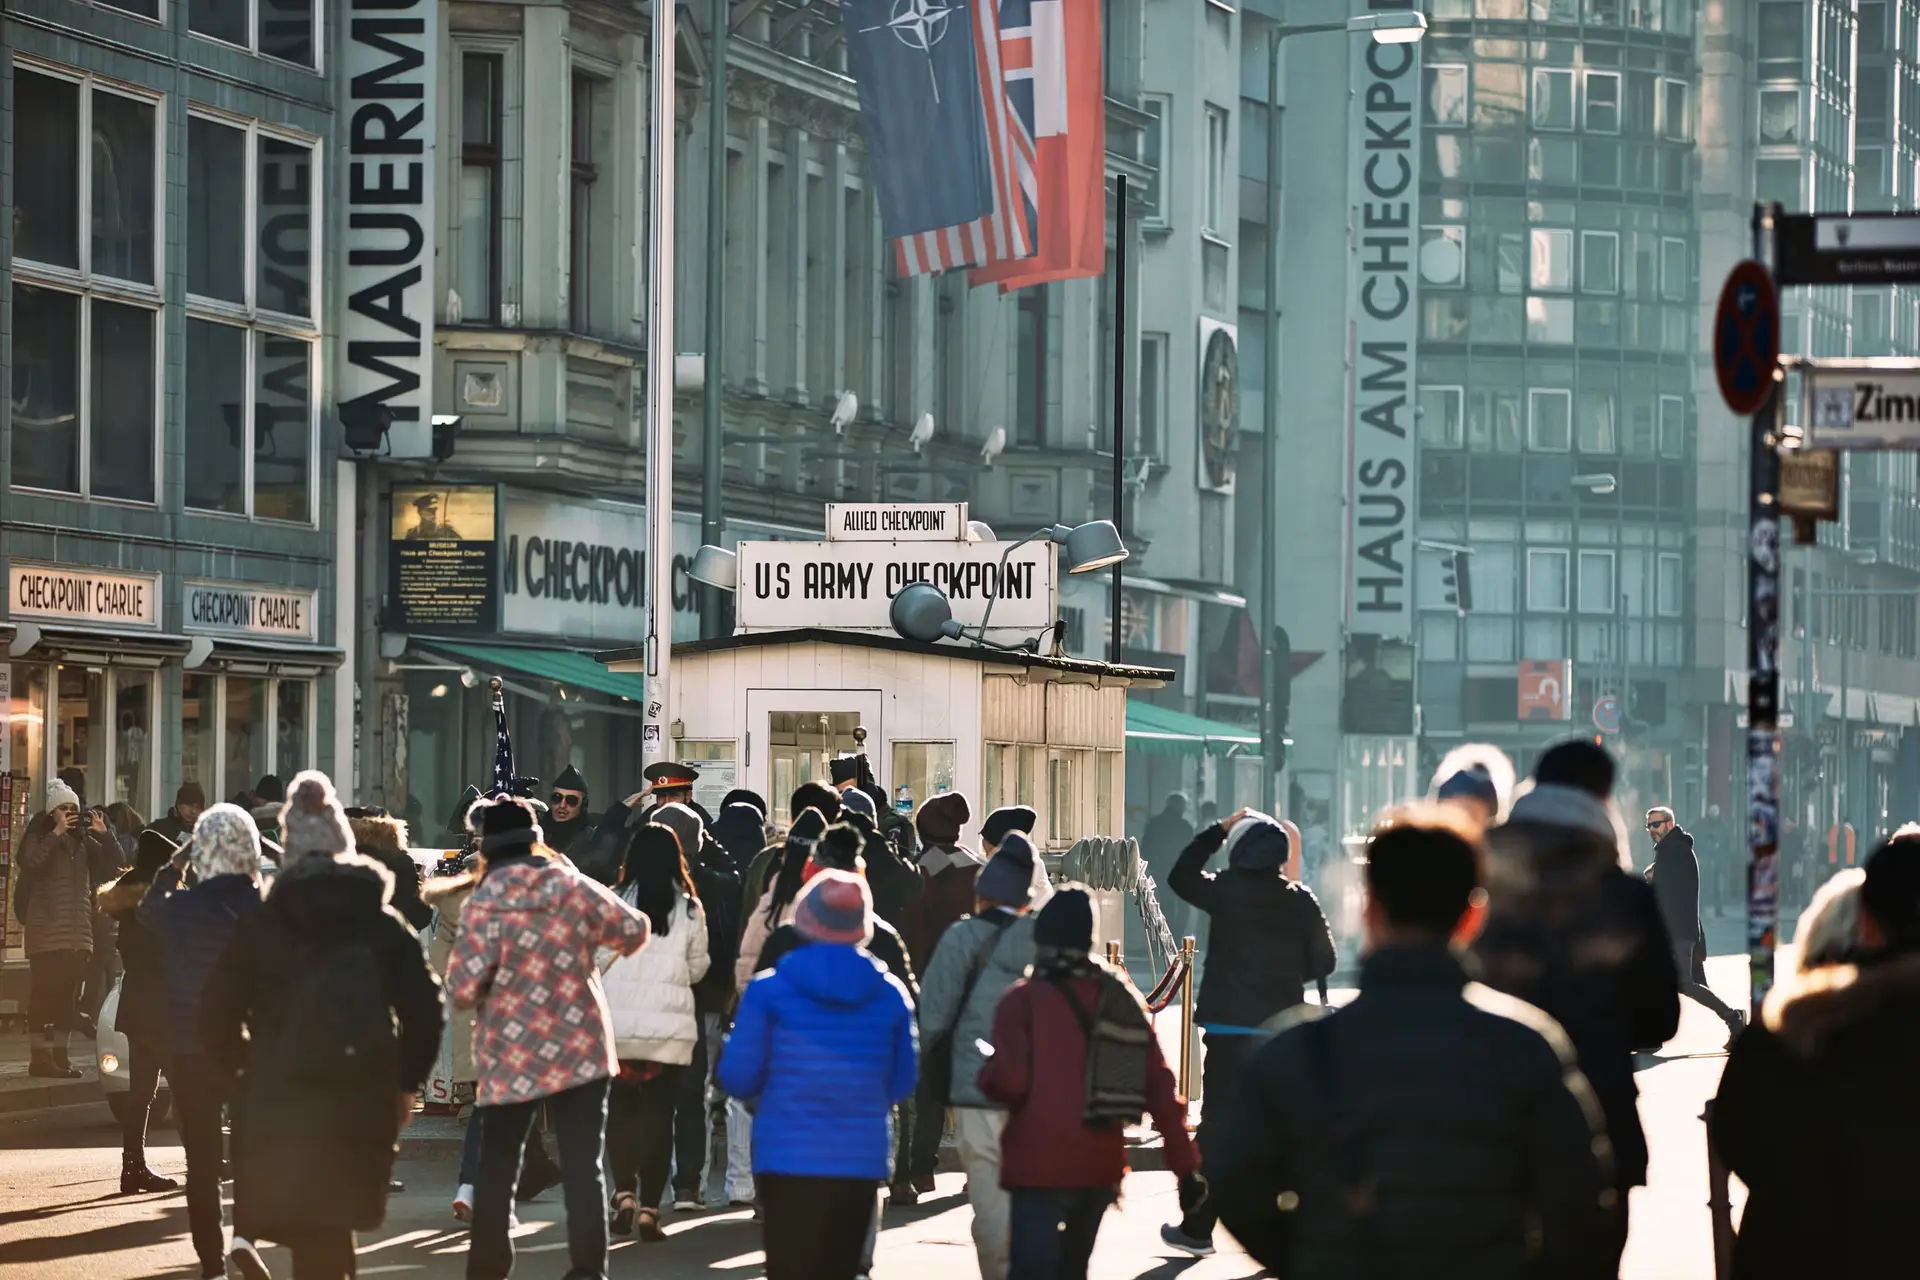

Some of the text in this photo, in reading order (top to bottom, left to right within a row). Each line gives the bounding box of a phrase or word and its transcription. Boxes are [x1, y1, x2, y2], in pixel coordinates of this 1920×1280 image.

[348, 0, 425, 421] MAUERM
[1361, 341, 1407, 440] AM
[1855, 383, 1920, 422] Zim
[844, 510, 946, 531] ALLIED CHECKPOINT
[1357, 458, 1407, 613] HAUS
[525, 536, 646, 608] CHECKPOI
[804, 562, 874, 599] ARMY
[886, 562, 1036, 599] CHECKPOINT
[19, 574, 143, 617] CHECKPOINT CHARLIE
[191, 590, 301, 630] CHECKPOINT CHARLIE
